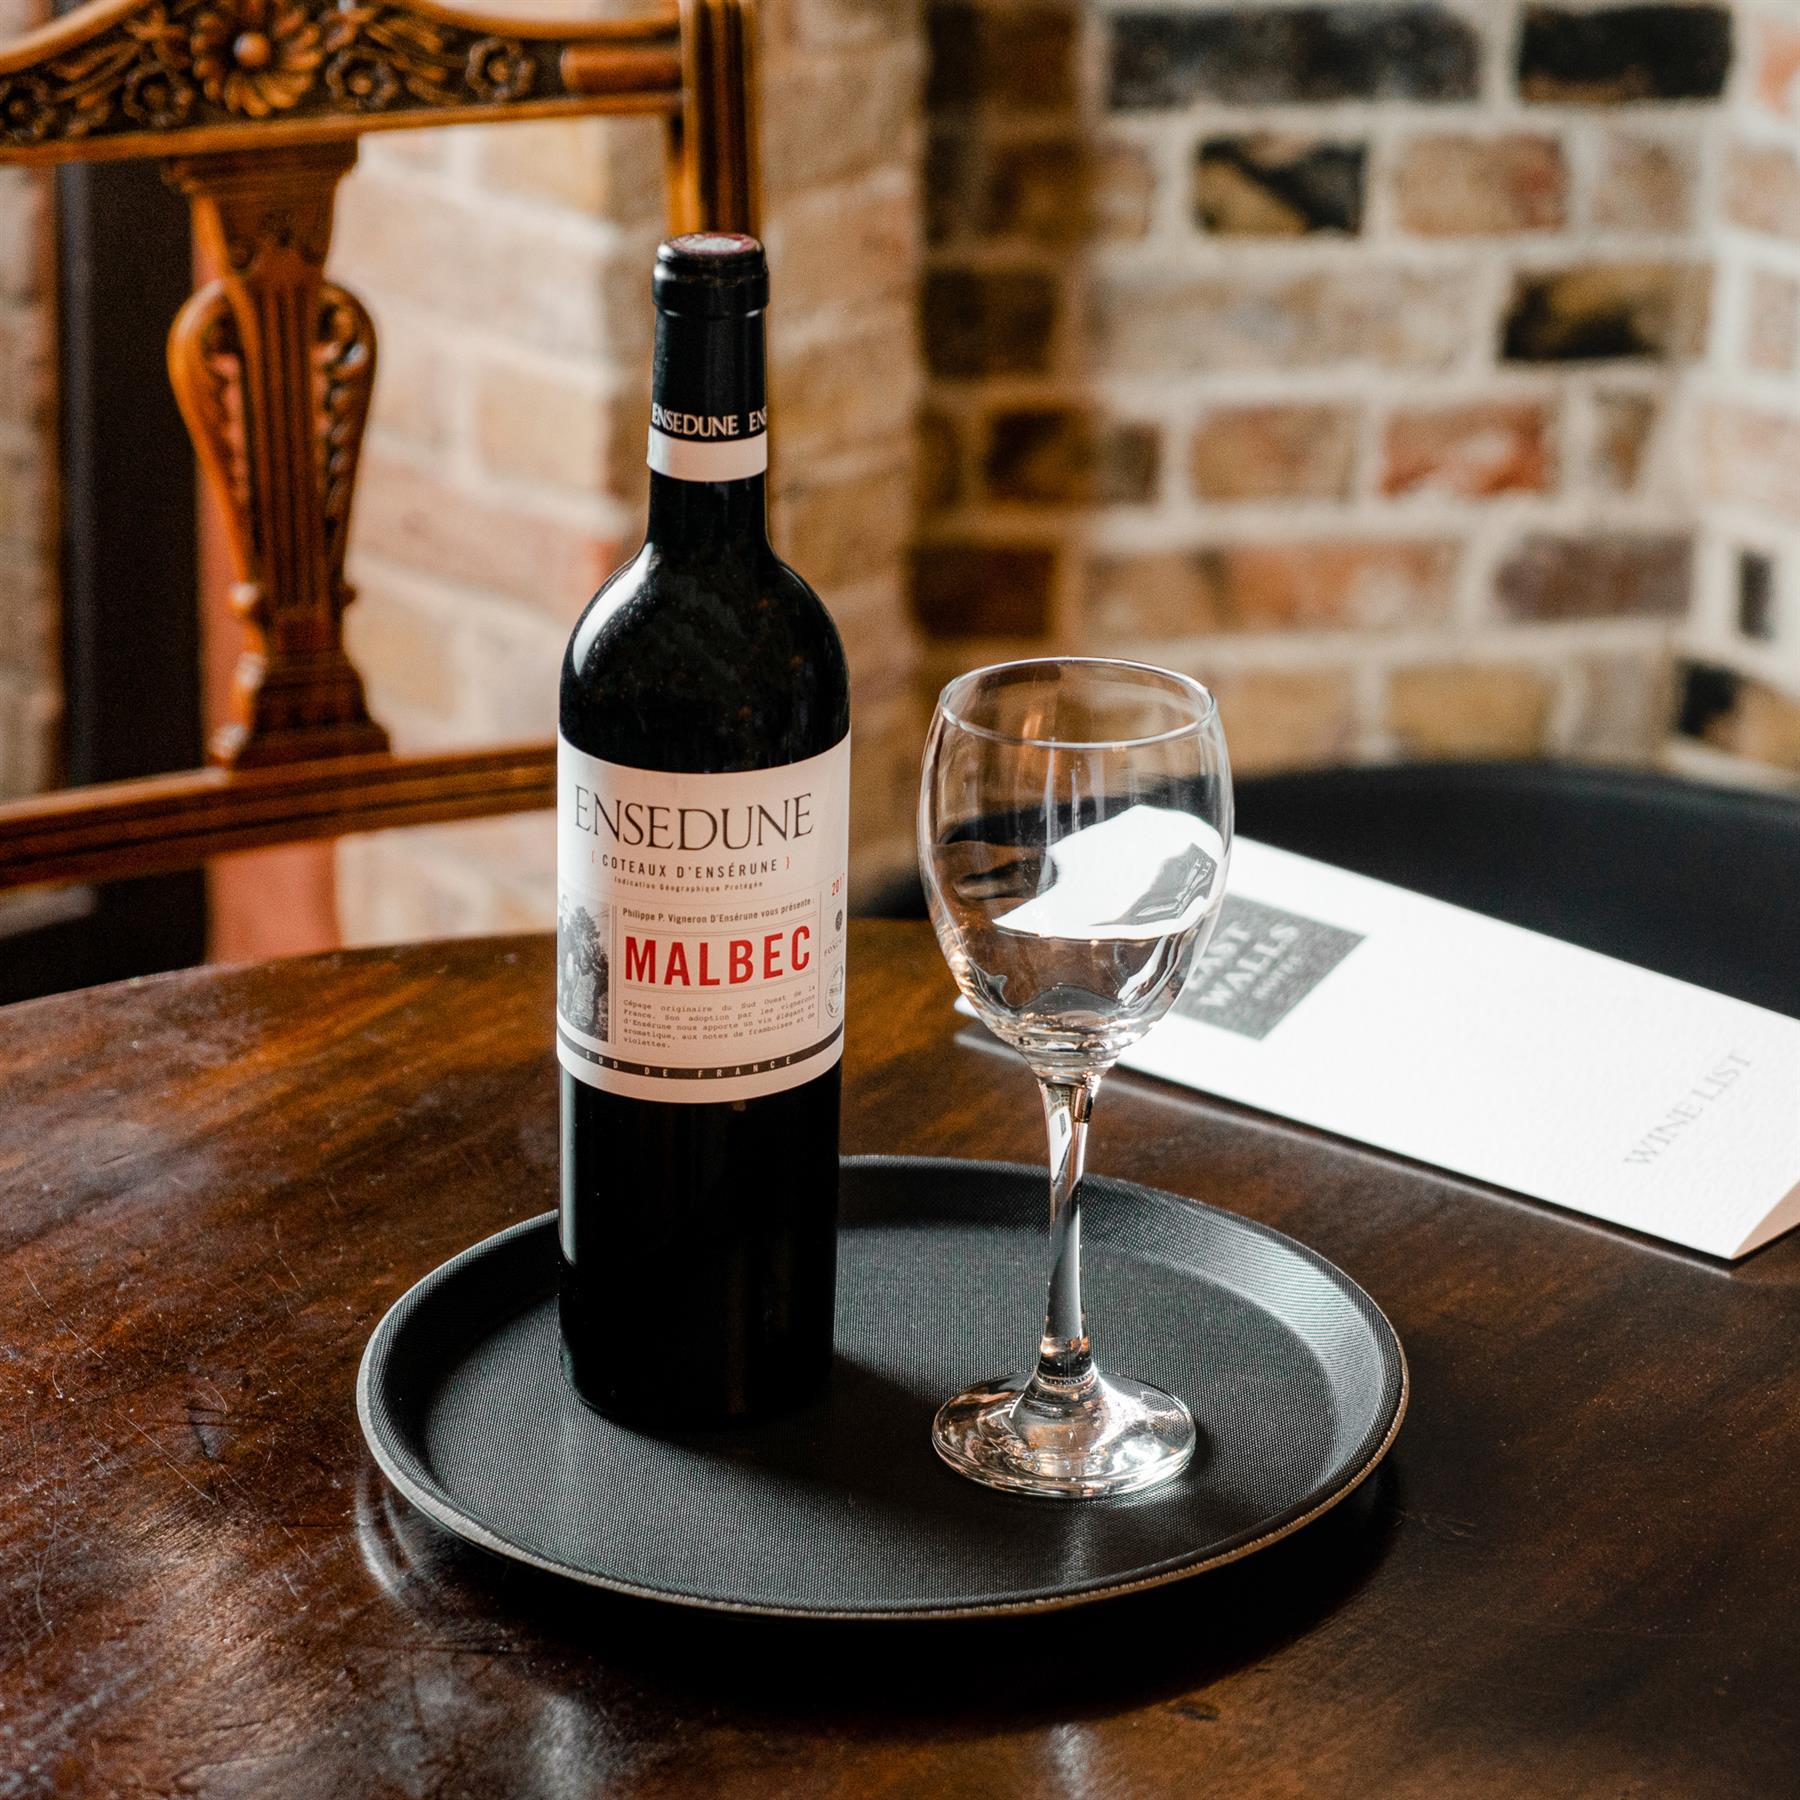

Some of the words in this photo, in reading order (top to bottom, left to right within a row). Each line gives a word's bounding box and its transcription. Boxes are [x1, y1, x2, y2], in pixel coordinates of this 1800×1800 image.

[652, 402, 739, 437] ENSEDUNE
[575, 785, 814, 850] ENSEDUNE
[602, 854, 666, 877] COTEAUX
[677, 859, 777, 878] D'ENSÉRUNE
[623, 907, 655, 921] Philippe
[659, 912, 665, 922] P.
[668, 914, 707, 925] Vigneron
[710, 912, 758, 923] D'Ensérune
[761, 908, 779, 918] vous
[780, 898, 811, 914] présente
[625, 925, 810, 986] MALBEC
[1199, 923, 1299, 1008] WALLS
[623, 999, 652, 1010] Cépage
[660, 1005, 713, 1013] originaire
[722, 1004, 733, 1012] du
[741, 1001, 756, 1010] Sud
[764, 995, 786, 1005] Ouest
[623, 1008, 656, 1020] France.
[664, 1014, 680, 1022] Son
[689, 1013, 730, 1023] adoption
[737, 1012, 753, 1021] par
[761, 1008, 774, 1016] les
[623, 1028, 676, 1041] aromatique,
[702, 1032, 729, 1040] notes
[702, 1023, 739, 1032] apporte
[623, 1036, 671, 1049] violettes.
[644, 1065, 669, 1078] DE
[697, 1055, 792, 1079] FRANCE
[1624, 1101, 1704, 1164] WINE
[1691, 1050, 1752, 1101] LIST
